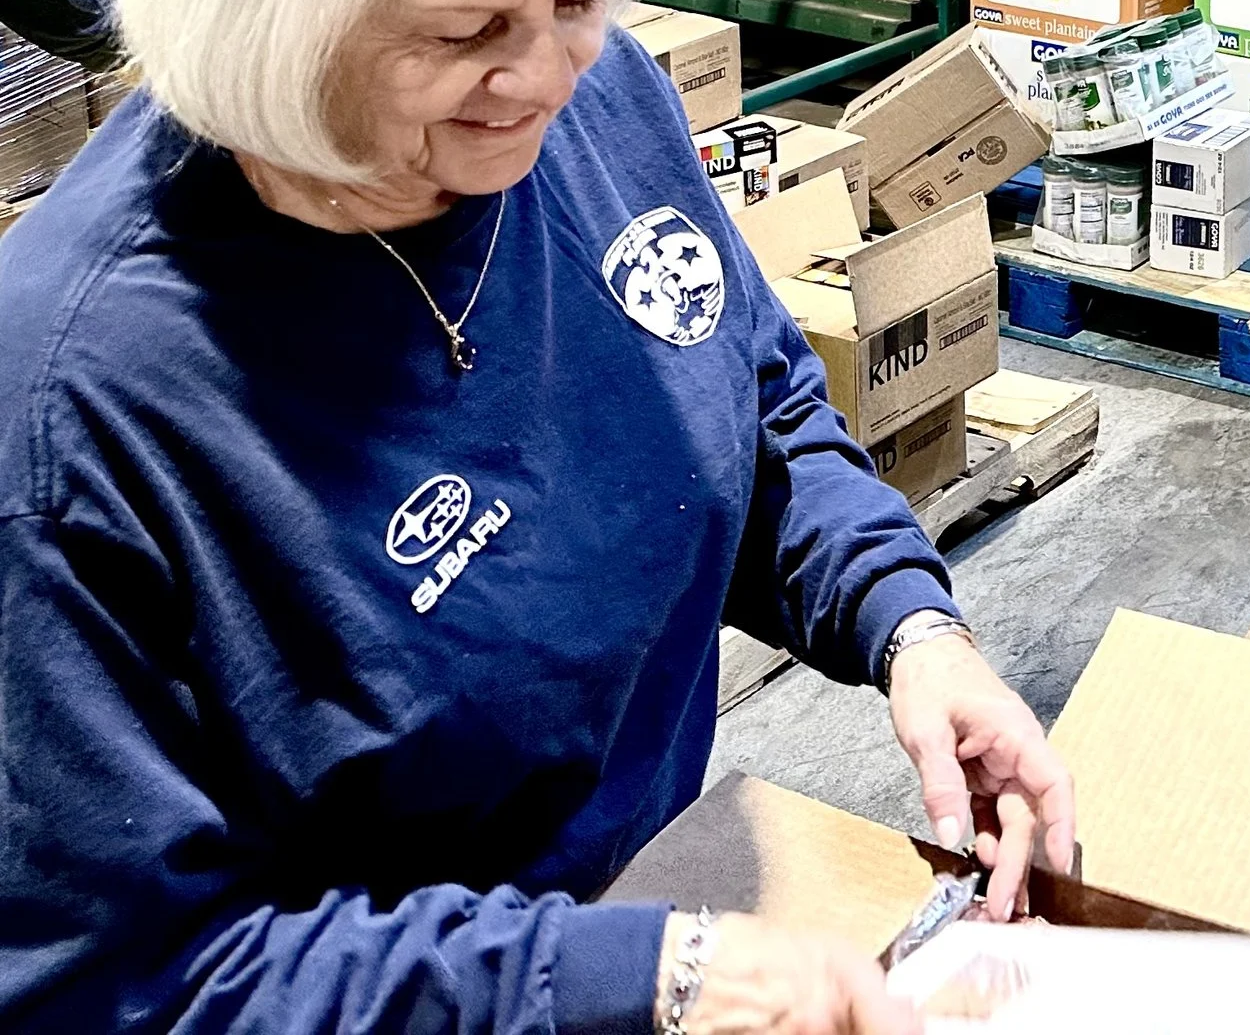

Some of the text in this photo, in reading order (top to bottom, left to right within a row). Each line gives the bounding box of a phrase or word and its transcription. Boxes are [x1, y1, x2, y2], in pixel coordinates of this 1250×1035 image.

[975, 8, 1002, 22] GOYA
[1005, 15, 1041, 31] sweet
[1218, 34, 1239, 48] YA
[1160, 106, 1183, 124] GOYA
[705, 157, 736, 174] IND
[753, 168, 763, 192] KIND
[1210, 222, 1219, 248] GOYA
[869, 339, 928, 391] KIND
[410, 498, 512, 614] SUBARU
